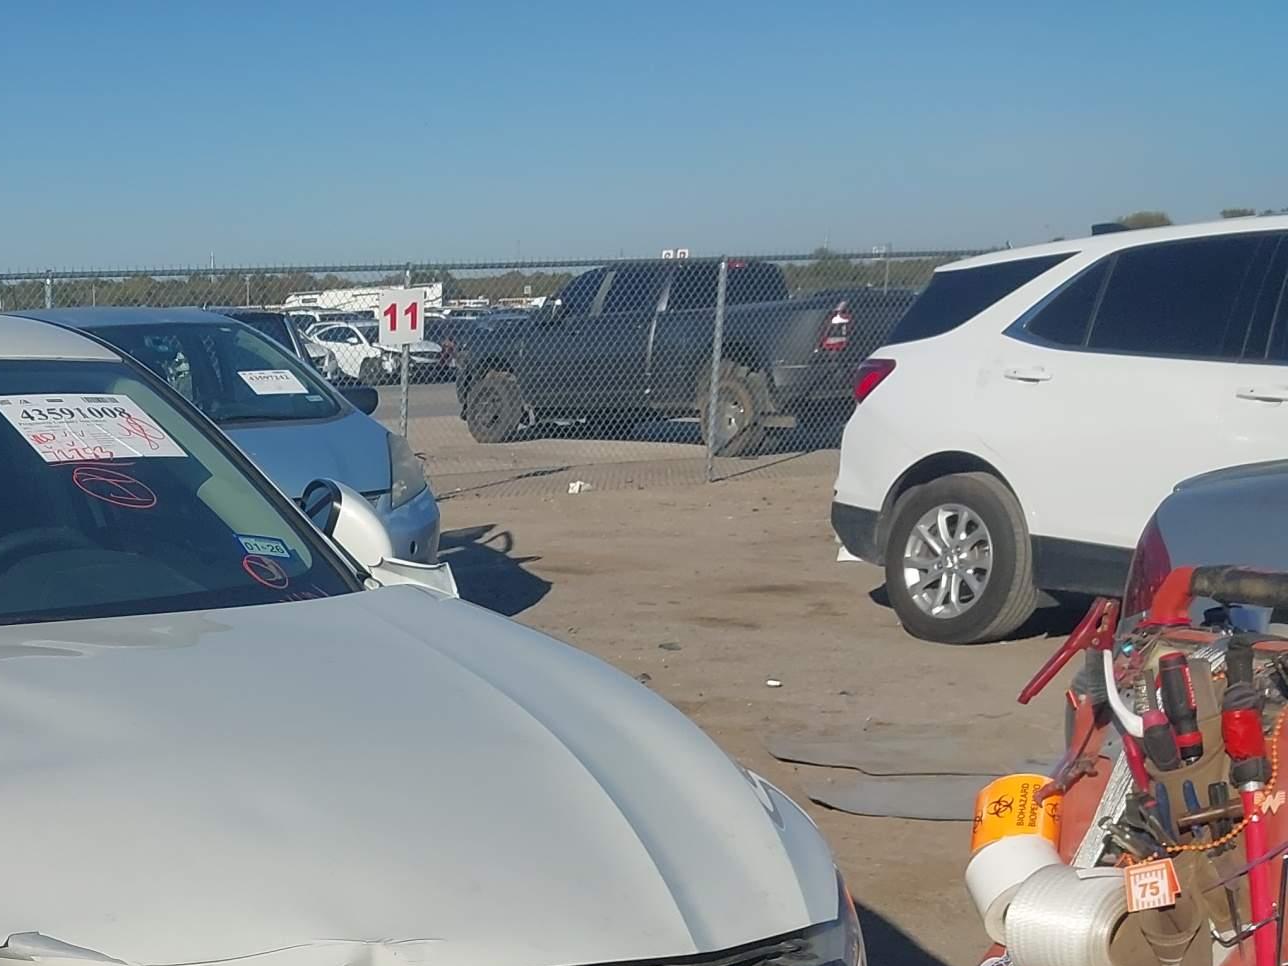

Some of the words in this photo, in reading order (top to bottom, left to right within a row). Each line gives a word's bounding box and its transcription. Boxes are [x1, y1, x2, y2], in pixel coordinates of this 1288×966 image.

[383, 302, 418, 331] 11
[20, 406, 131, 421] 43591008
[1016, 783, 1030, 826] BIOHAZARD
[1138, 880, 1160, 898] 75
